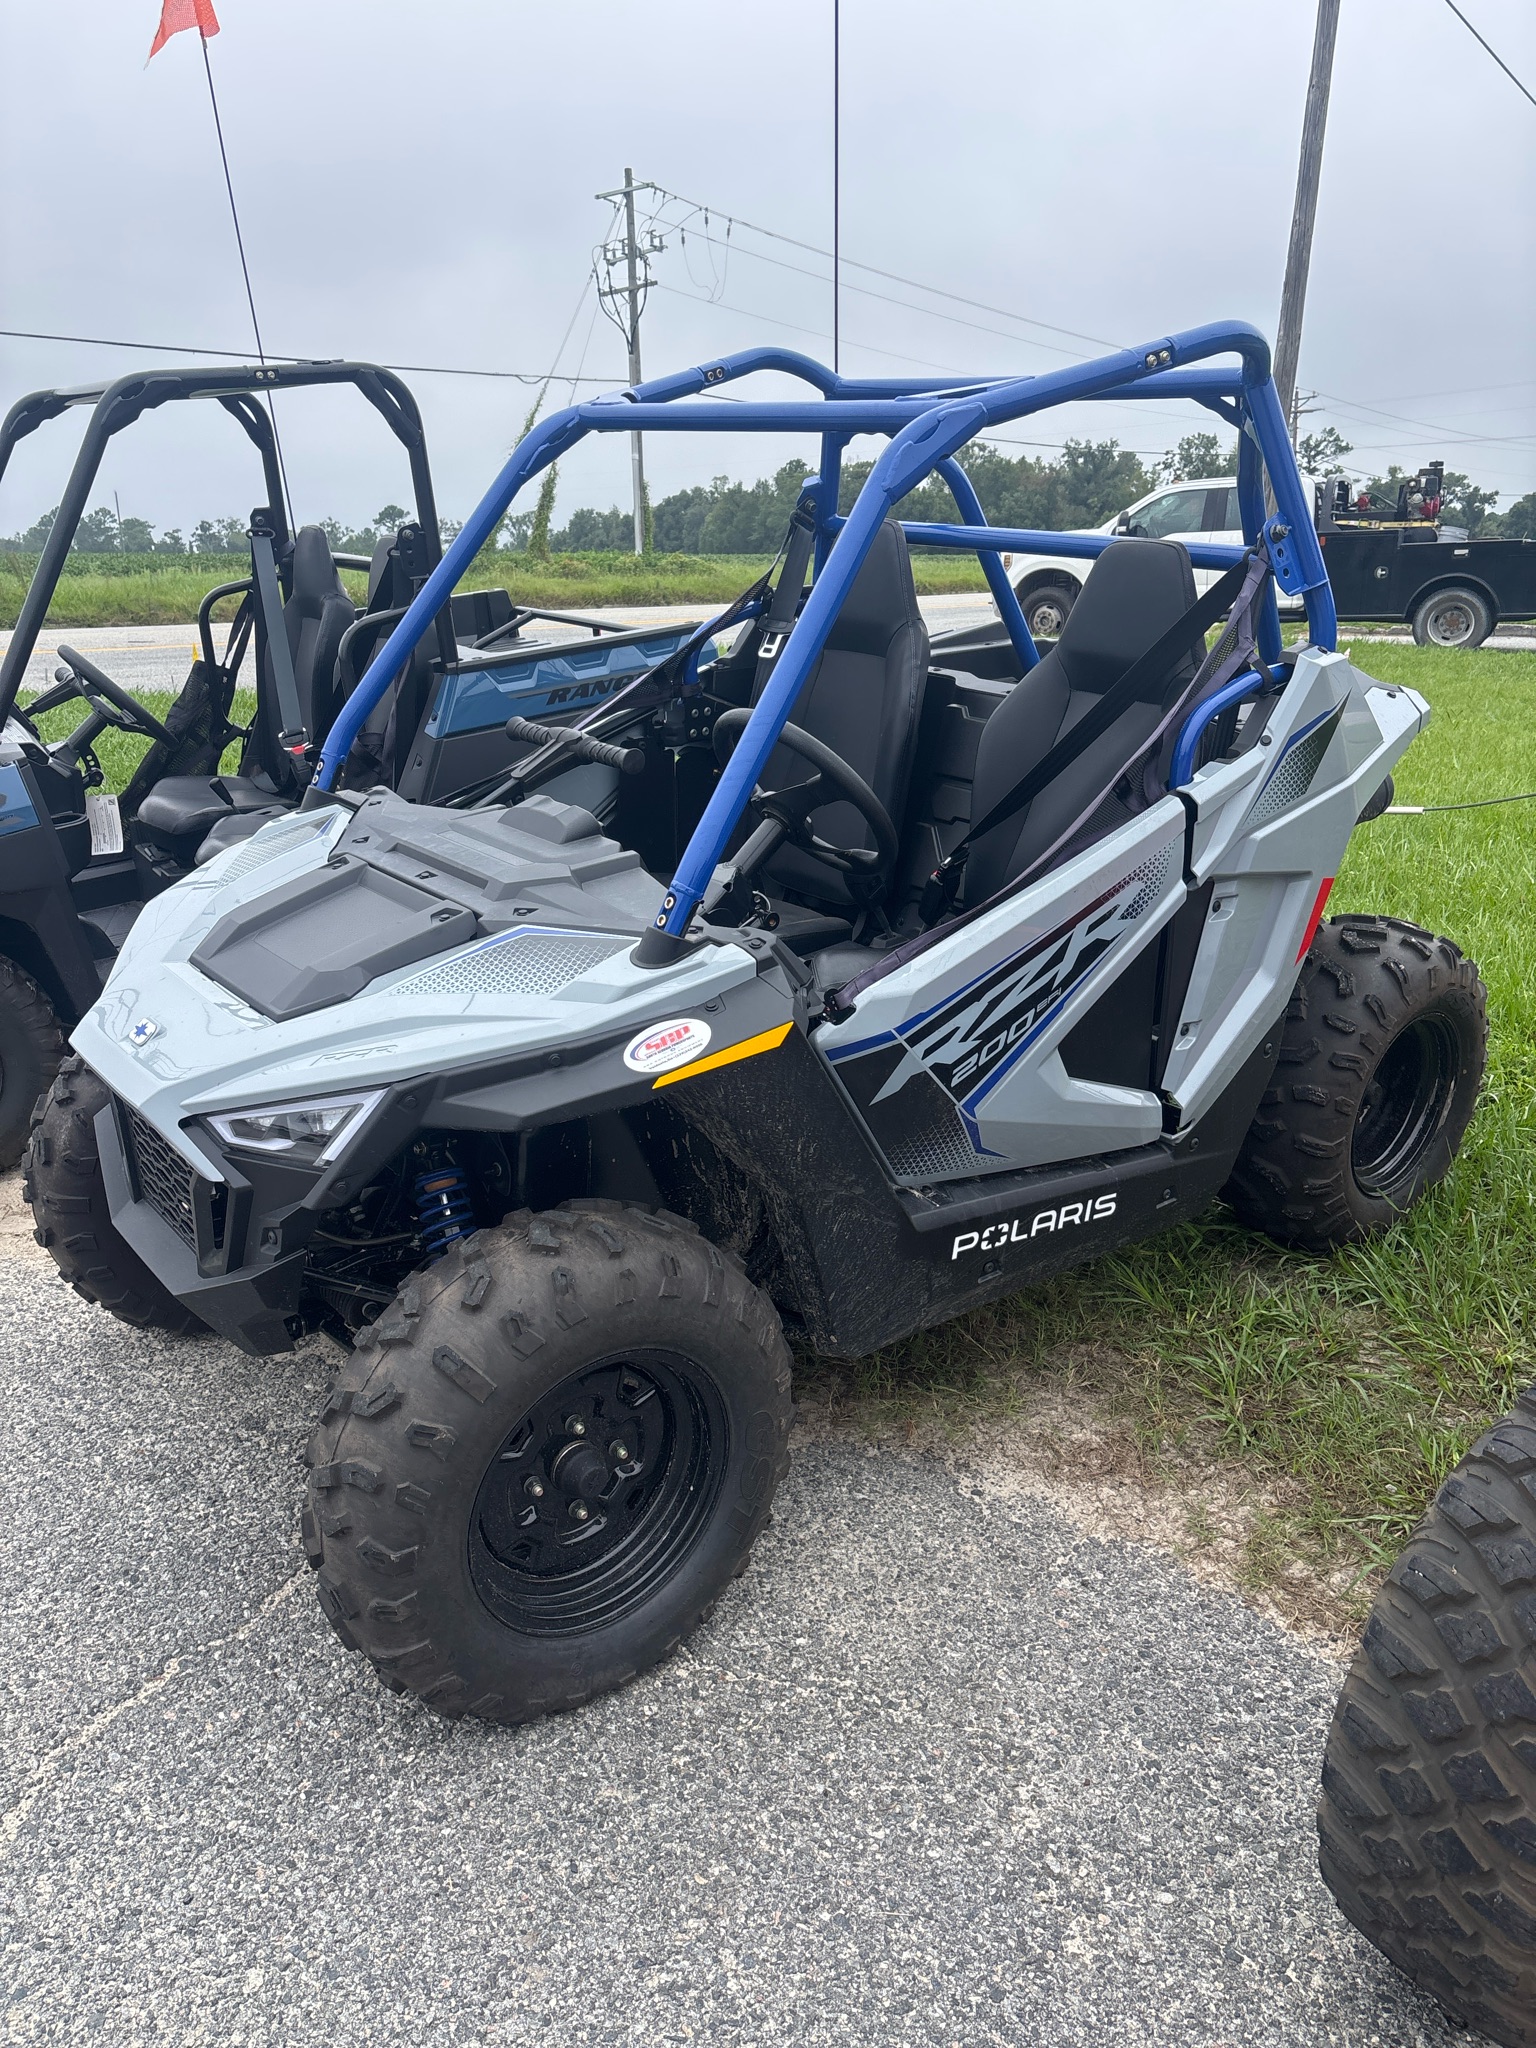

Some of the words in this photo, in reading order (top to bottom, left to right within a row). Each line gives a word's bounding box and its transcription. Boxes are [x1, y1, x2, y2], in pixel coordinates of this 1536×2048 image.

[546, 671, 648, 706] RANG
[869, 881, 1147, 1106] RZR
[950, 1007, 1036, 1088] 200
[1036, 986, 1062, 1013] EFI
[950, 1192, 1118, 1260] POLARIS
